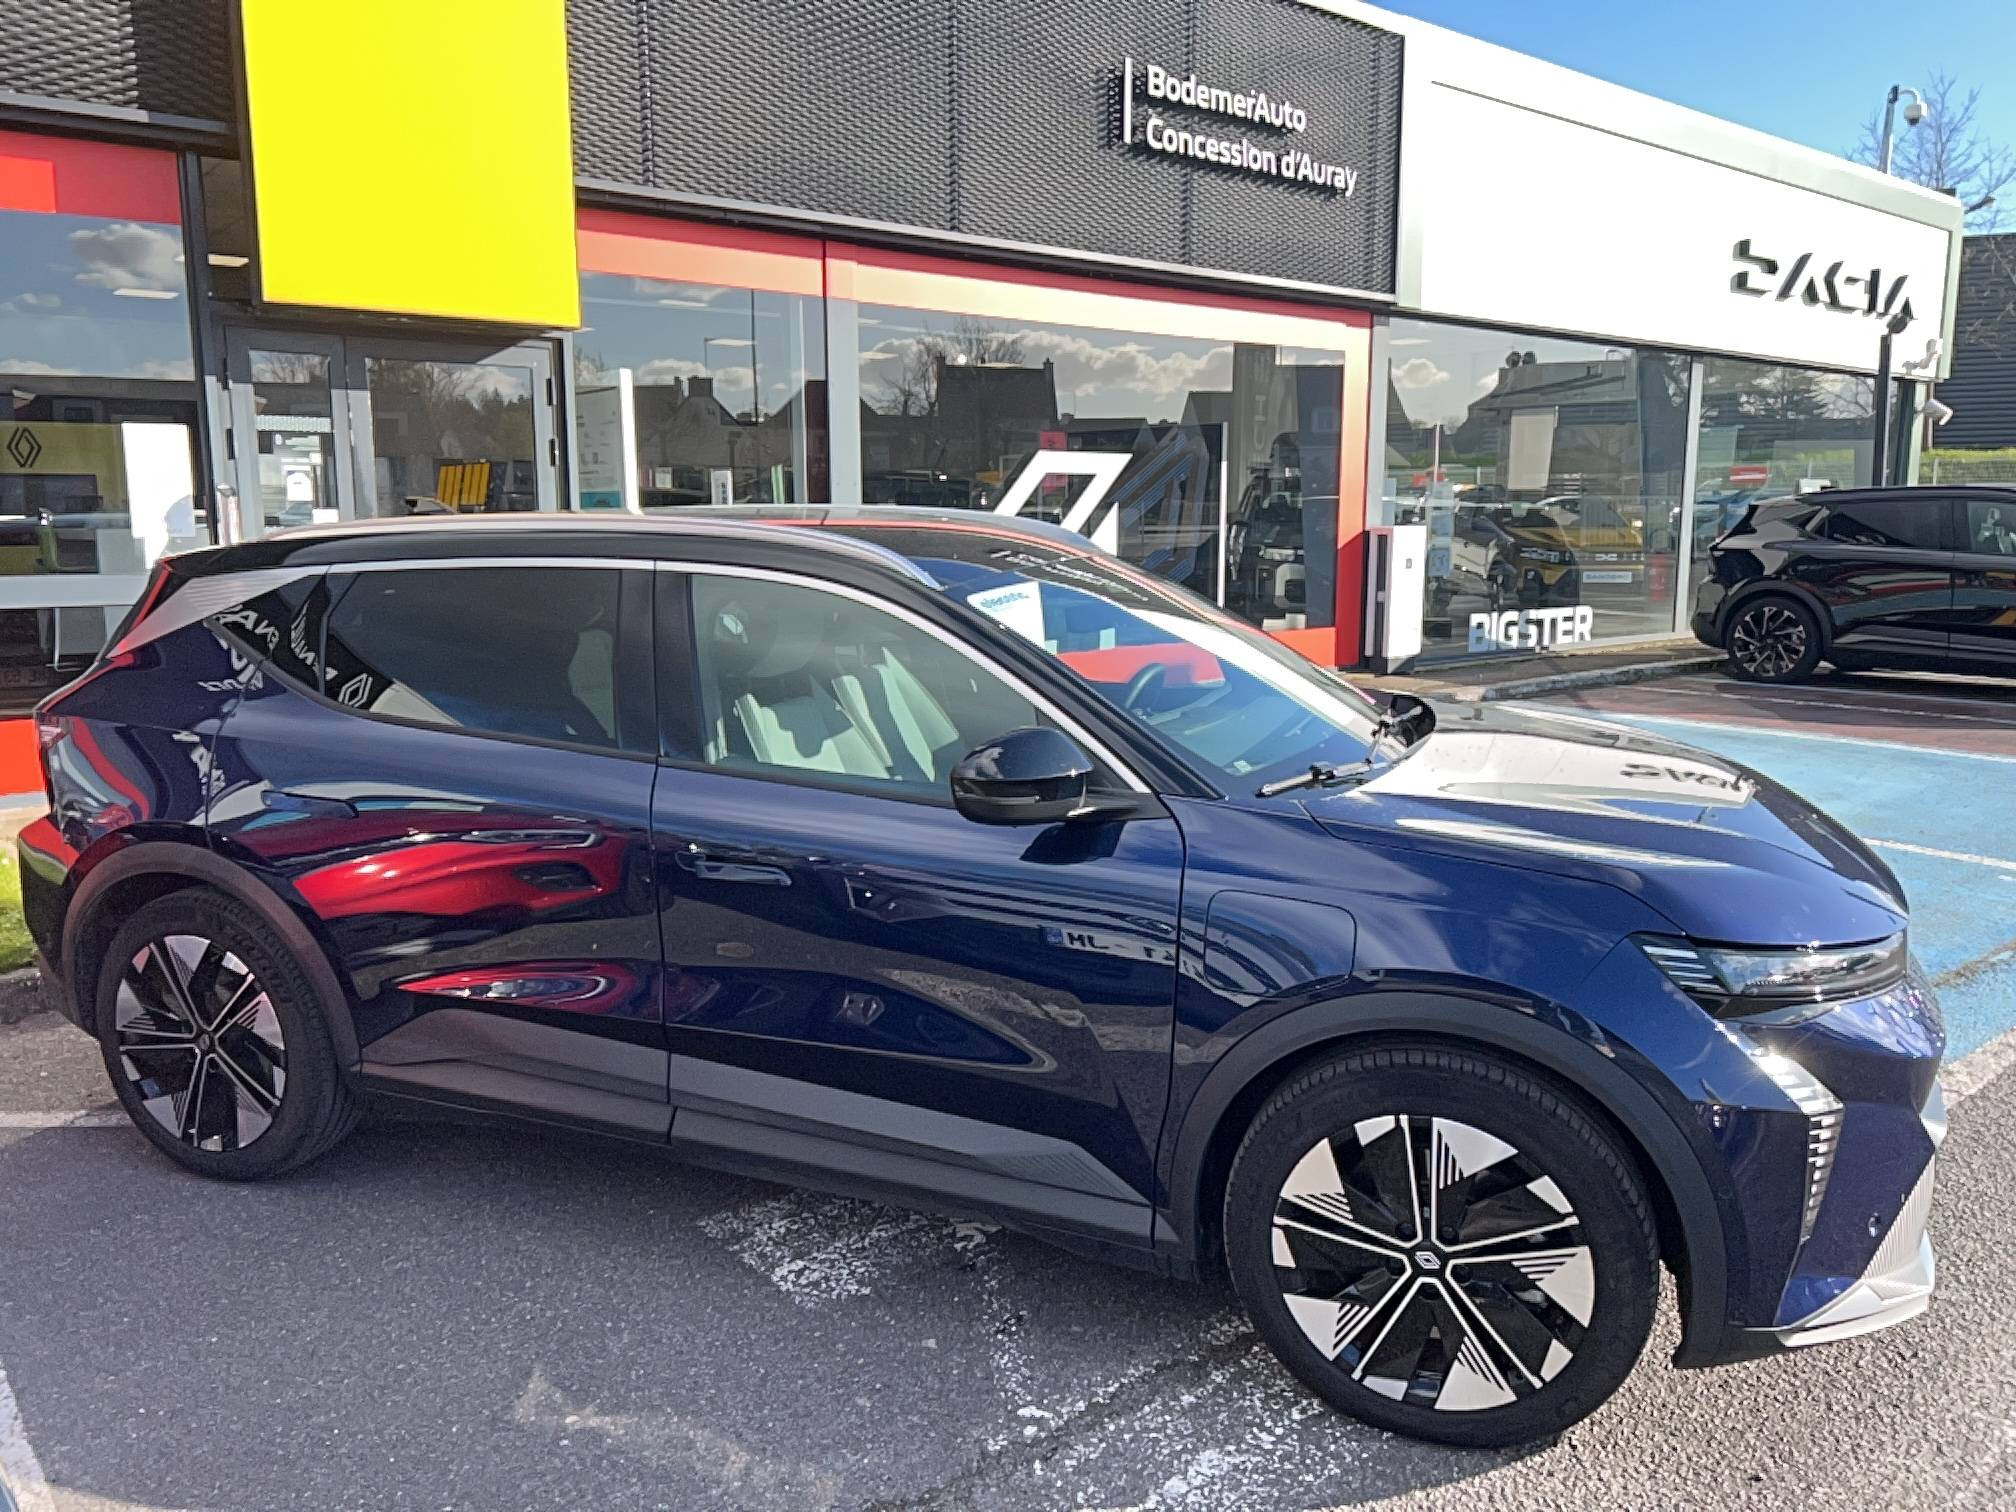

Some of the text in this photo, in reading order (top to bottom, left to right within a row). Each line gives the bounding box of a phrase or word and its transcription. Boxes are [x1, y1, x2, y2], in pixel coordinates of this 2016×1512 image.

[1146, 117, 1358, 197] Concession d'Auray
[1730, 238, 1917, 321] DACIA
[1468, 604, 1594, 654] BIGSTER
